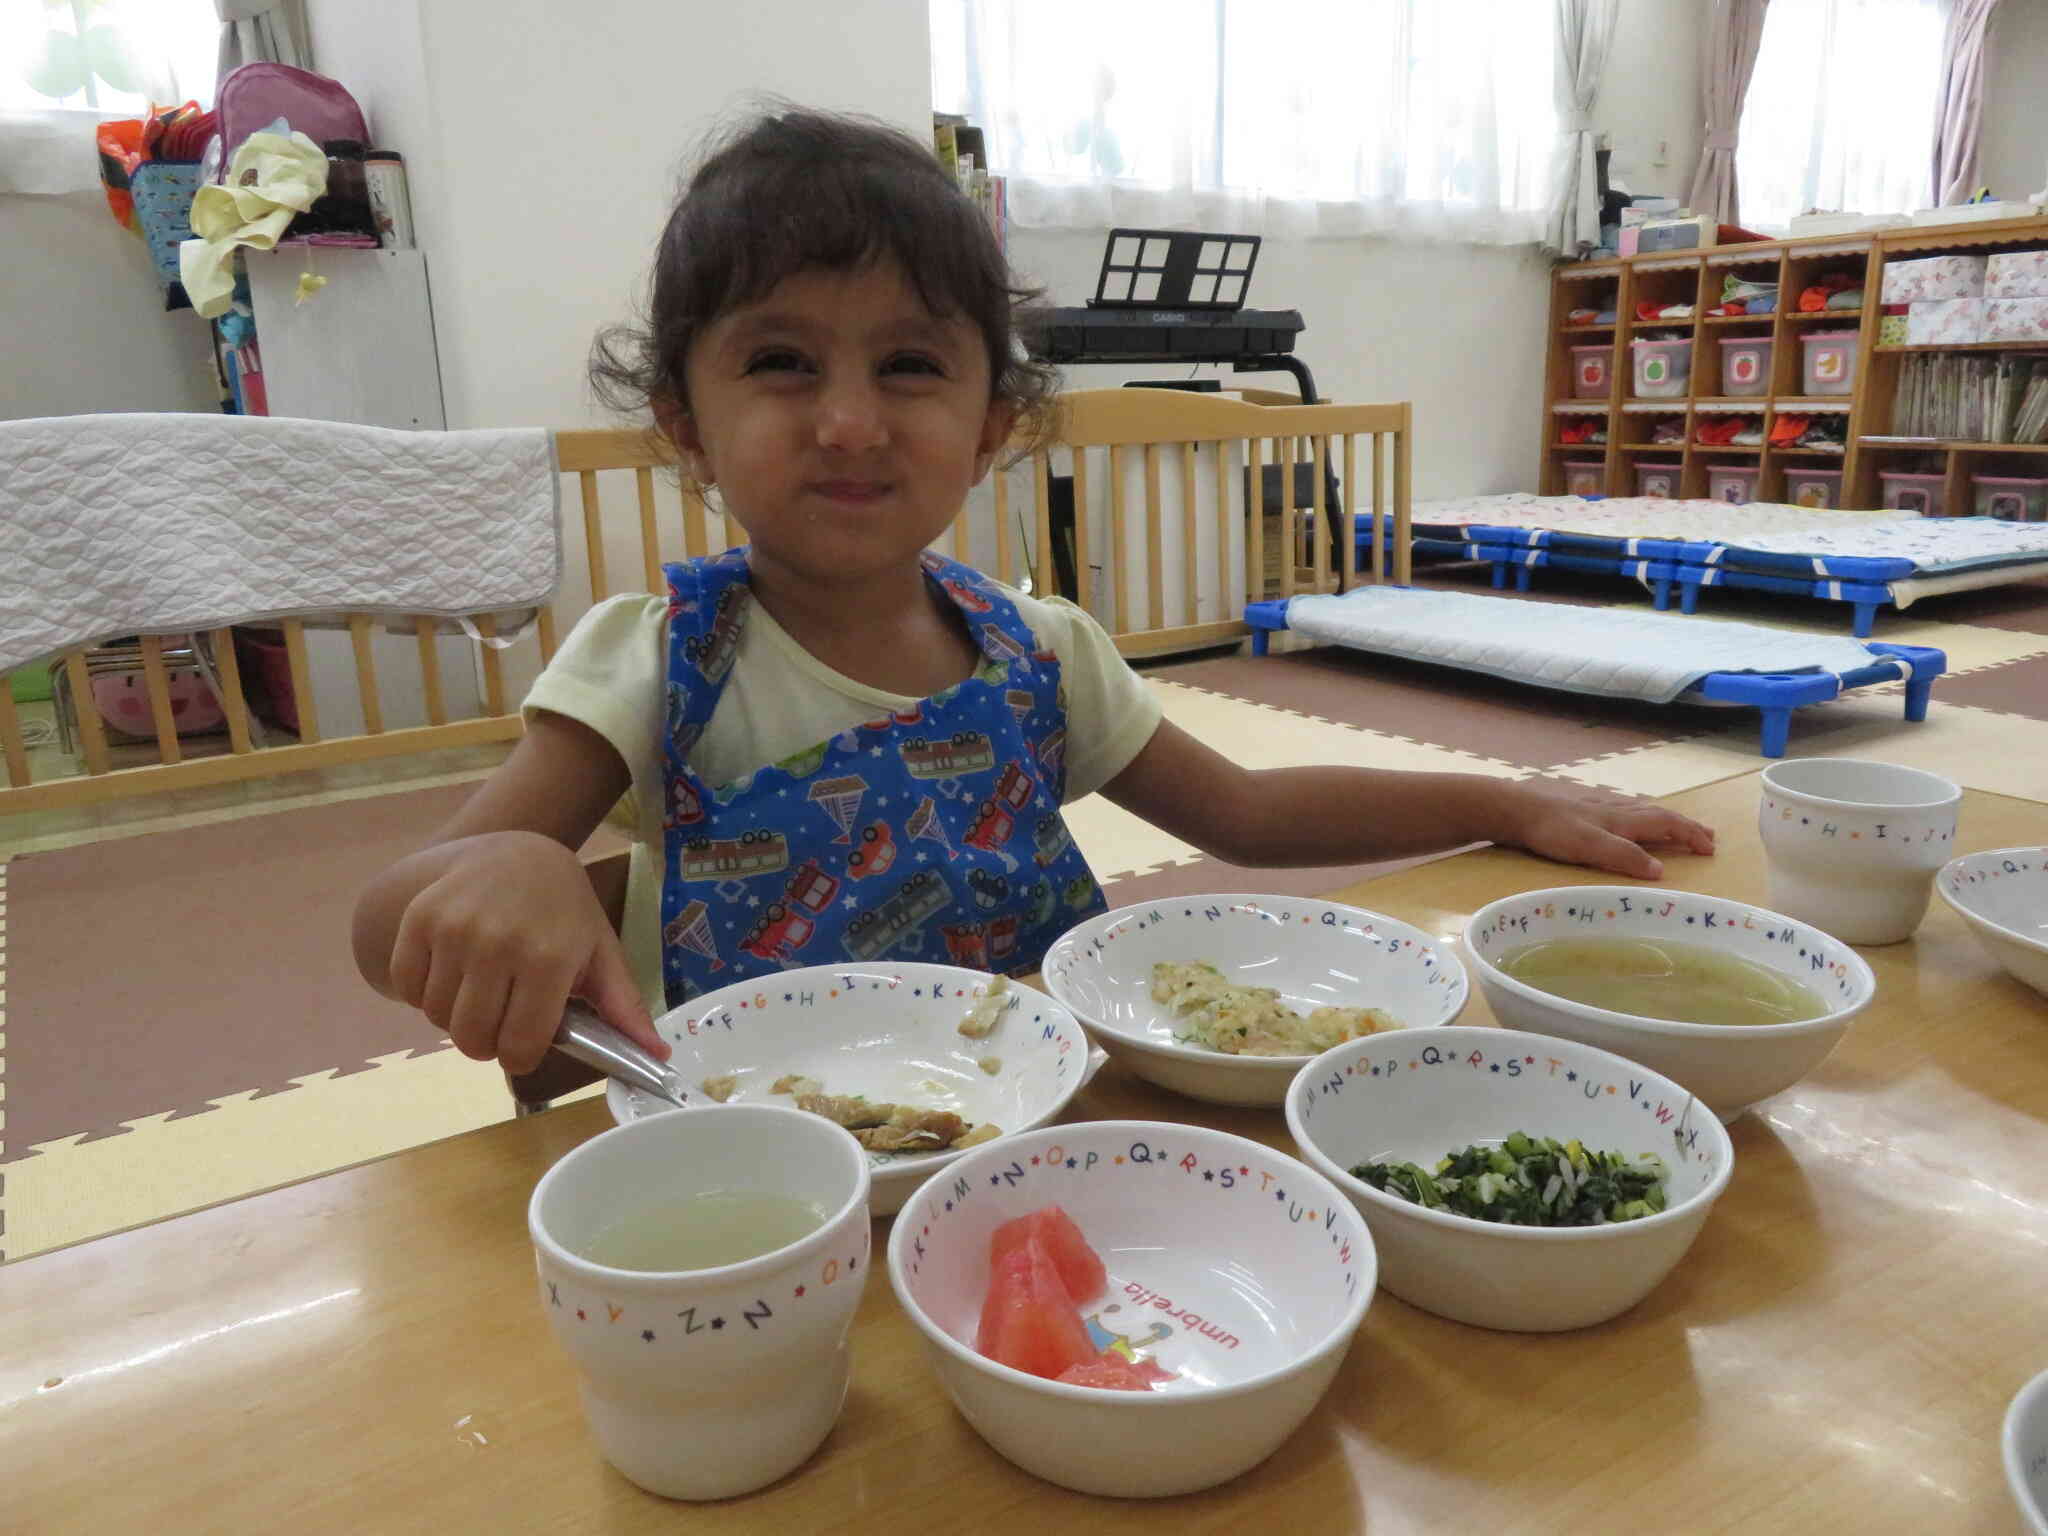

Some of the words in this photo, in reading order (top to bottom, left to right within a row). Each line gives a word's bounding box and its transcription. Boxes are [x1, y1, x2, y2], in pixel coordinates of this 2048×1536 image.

[1152, 312, 1185, 322] CASIO
[1822, 824, 1837, 837] H
[1876, 825, 1886, 838] I
[2002, 861, 2018, 873] Q
[1149, 910, 1163, 924] M
[1205, 906, 1221, 921] N
[1321, 912, 1336, 926] Q
[1389, 940, 1399, 952] S
[1520, 917, 1528, 932] F
[1543, 904, 1553, 918] G
[1580, 908, 1594, 922] H
[1620, 898, 1632, 912] I
[1660, 902, 1675, 917] J
[1705, 913, 1716, 927] K
[1780, 929, 1794, 944] M
[1812, 954, 1823, 970] N
[687, 1020, 698, 1035] E
[721, 1013, 732, 1030] F
[755, 993, 767, 1008] G
[800, 992, 813, 1006] H
[843, 976, 855, 990] I
[934, 984, 943, 998] K
[1042, 1024, 1056, 1041] N
[1330, 1072, 1344, 1094] N
[1357, 1057, 1369, 1076] O
[1387, 1060, 1397, 1078] P
[1422, 1047, 1443, 1065] Q
[1467, 1050, 1482, 1068] R
[1507, 1059, 1522, 1077] S
[1545, 1059, 1563, 1075] T
[1585, 1080, 1599, 1098] U
[1628, 1080, 1642, 1098] V
[1656, 1102, 1673, 1124] W
[1686, 1128, 1698, 1149] X
[915, 1236, 925, 1260] K
[954, 1177, 971, 1202] M
[1003, 1162, 1024, 1187] N
[1046, 1145, 1064, 1165] O
[1086, 1152, 1098, 1170] P
[1130, 1143, 1152, 1163] Q
[1180, 1153, 1197, 1173] R
[1221, 1168, 1234, 1188] S
[1261, 1171, 1275, 1192] T
[1289, 1201, 1303, 1224] U
[1326, 1208, 1336, 1230] V
[548, 1281, 561, 1307] X
[678, 1307, 705, 1335] Z
[744, 1300, 772, 1329] N
[823, 1259, 839, 1285] O
[1123, 1281, 1240, 1350] umbrella
